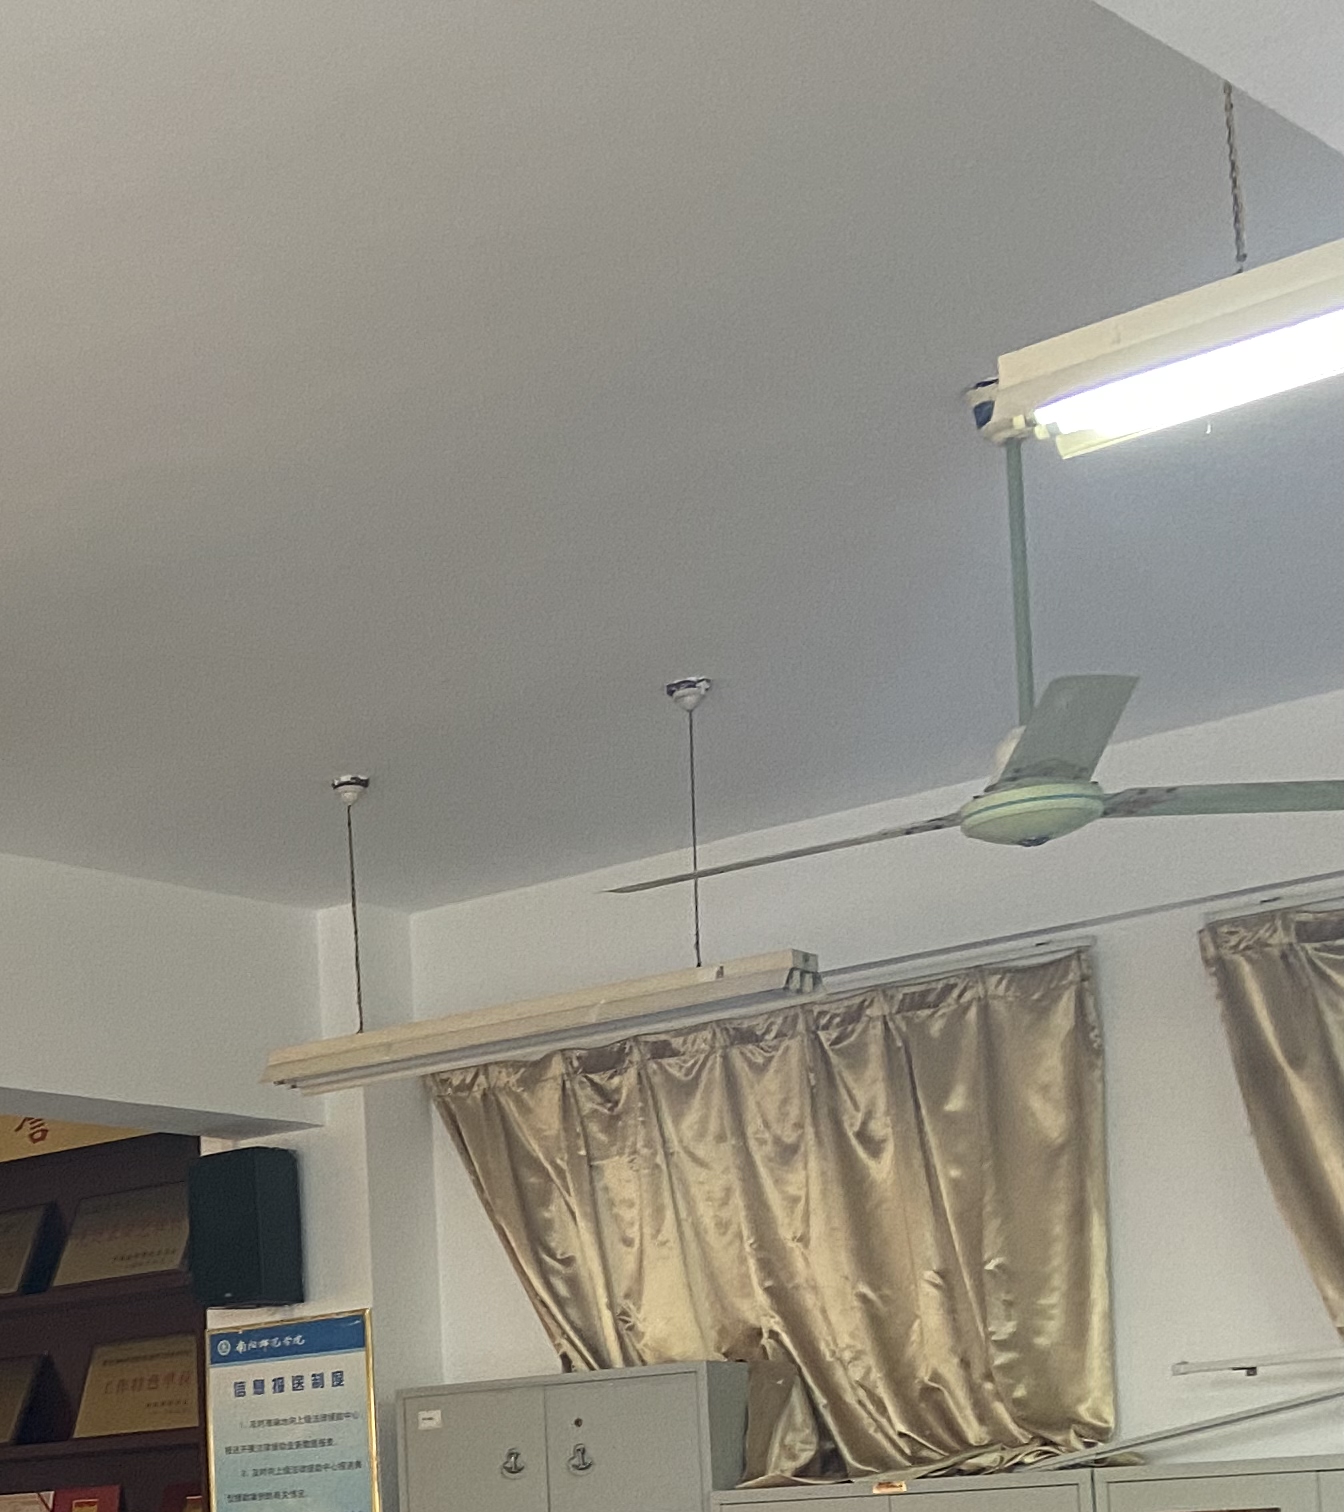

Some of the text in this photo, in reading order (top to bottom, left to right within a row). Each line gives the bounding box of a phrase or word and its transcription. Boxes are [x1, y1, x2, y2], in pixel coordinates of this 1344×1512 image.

[233, 1370, 345, 1398] 信息报送制度
